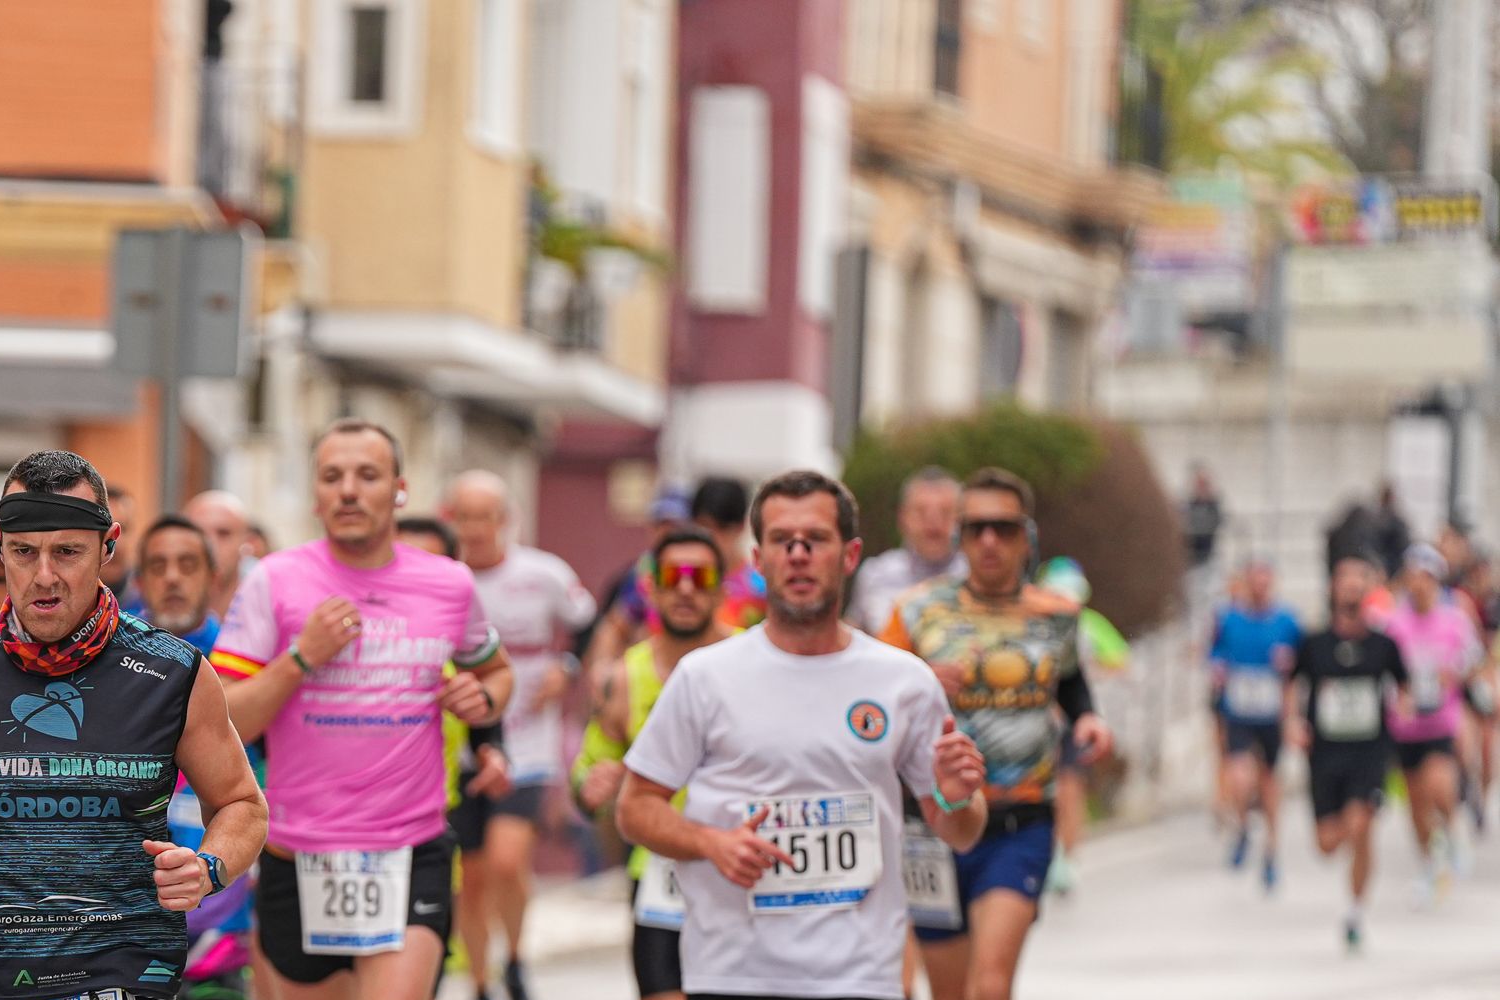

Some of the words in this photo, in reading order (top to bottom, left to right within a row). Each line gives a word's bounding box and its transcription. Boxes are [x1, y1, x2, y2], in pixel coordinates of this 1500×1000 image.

[120, 656, 145, 673] SIG
[143, 668, 167, 681] Laboral
[0, 758, 43, 777] VIDA
[49, 758, 94, 777] DONA
[96, 757, 163, 779] ÓRGANOS
[770, 831, 856, 875] 1510
[322, 879, 381, 918] 289
[48, 912, 123, 923] Emergencias
